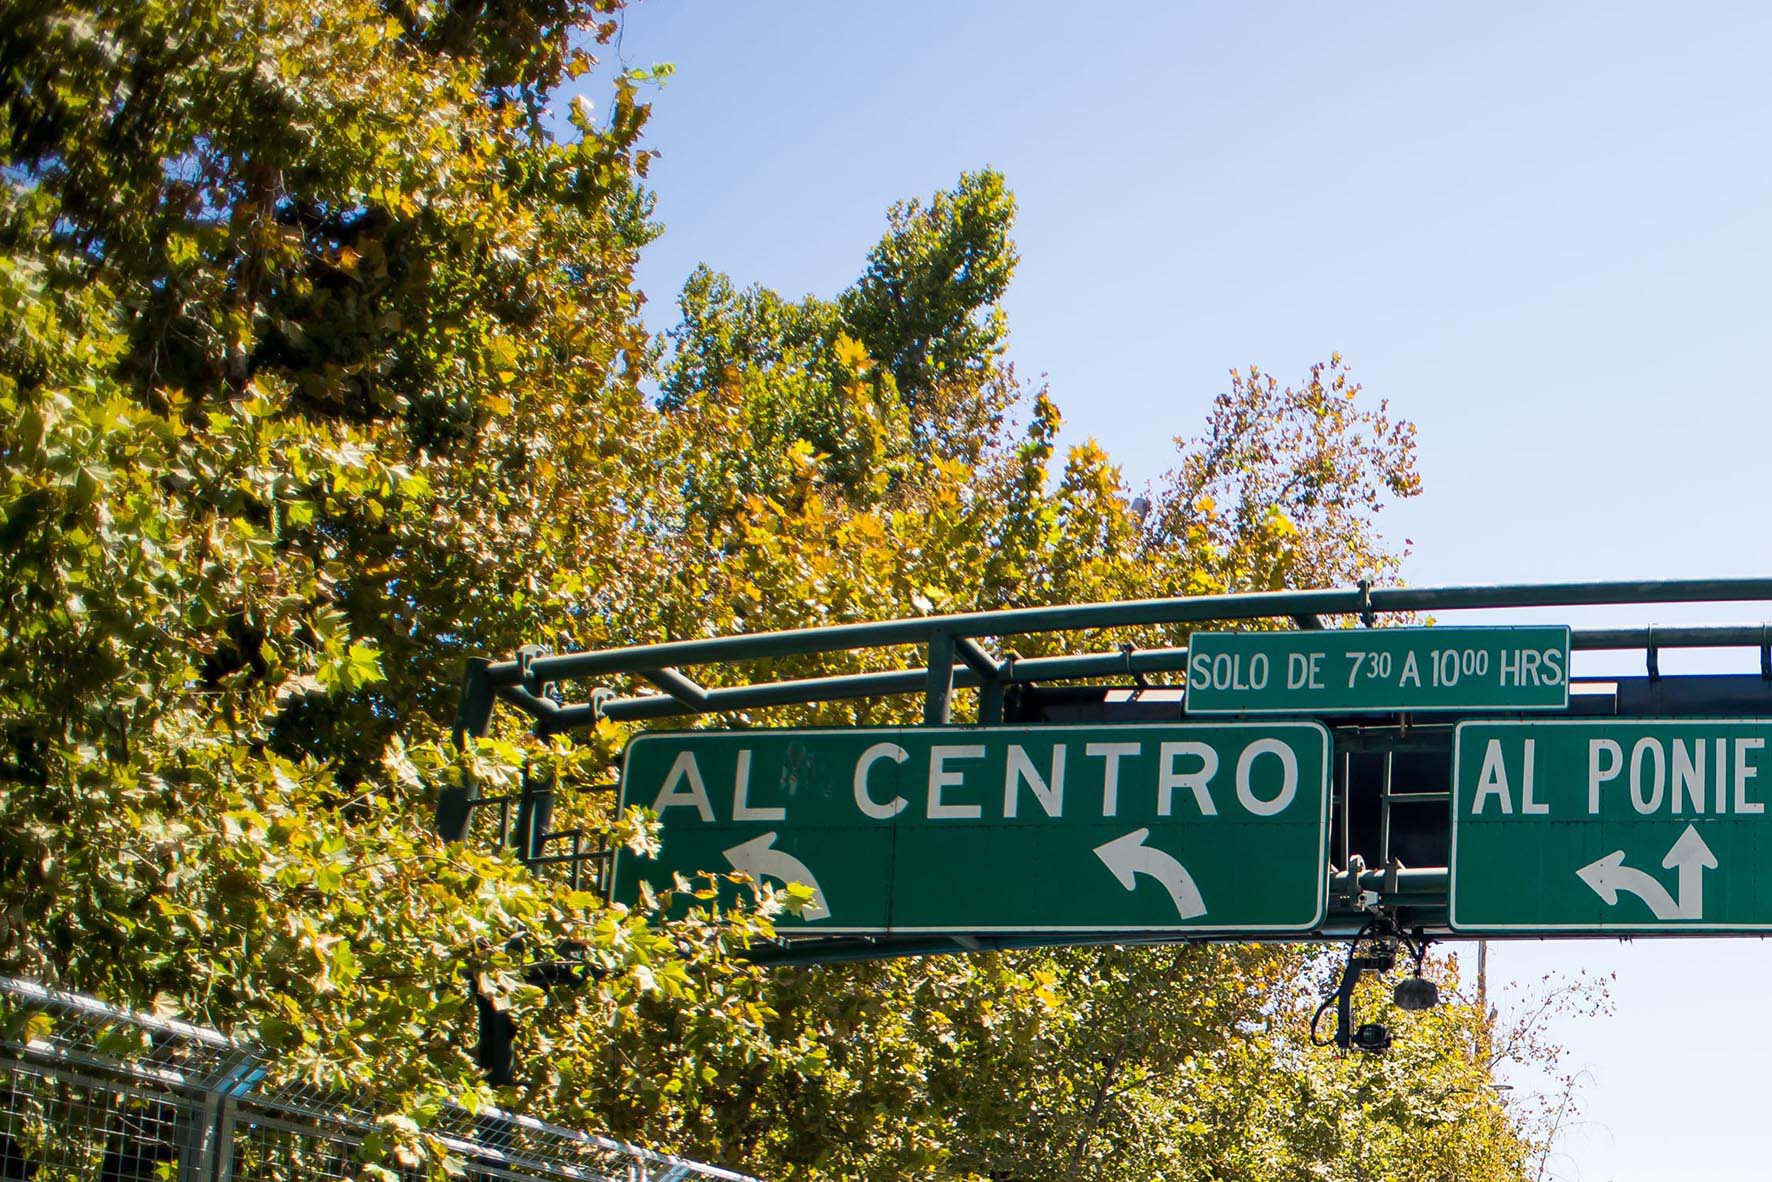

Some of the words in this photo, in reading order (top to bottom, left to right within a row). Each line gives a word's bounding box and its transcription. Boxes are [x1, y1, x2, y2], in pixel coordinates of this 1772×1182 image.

[1190, 652, 1269, 690] SOLO
[1287, 653, 1325, 689] DE
[1399, 650, 1421, 687] A
[650, 749, 785, 823] AL
[854, 737, 1298, 819] CENTRO
[1471, 738, 1550, 815] AL
